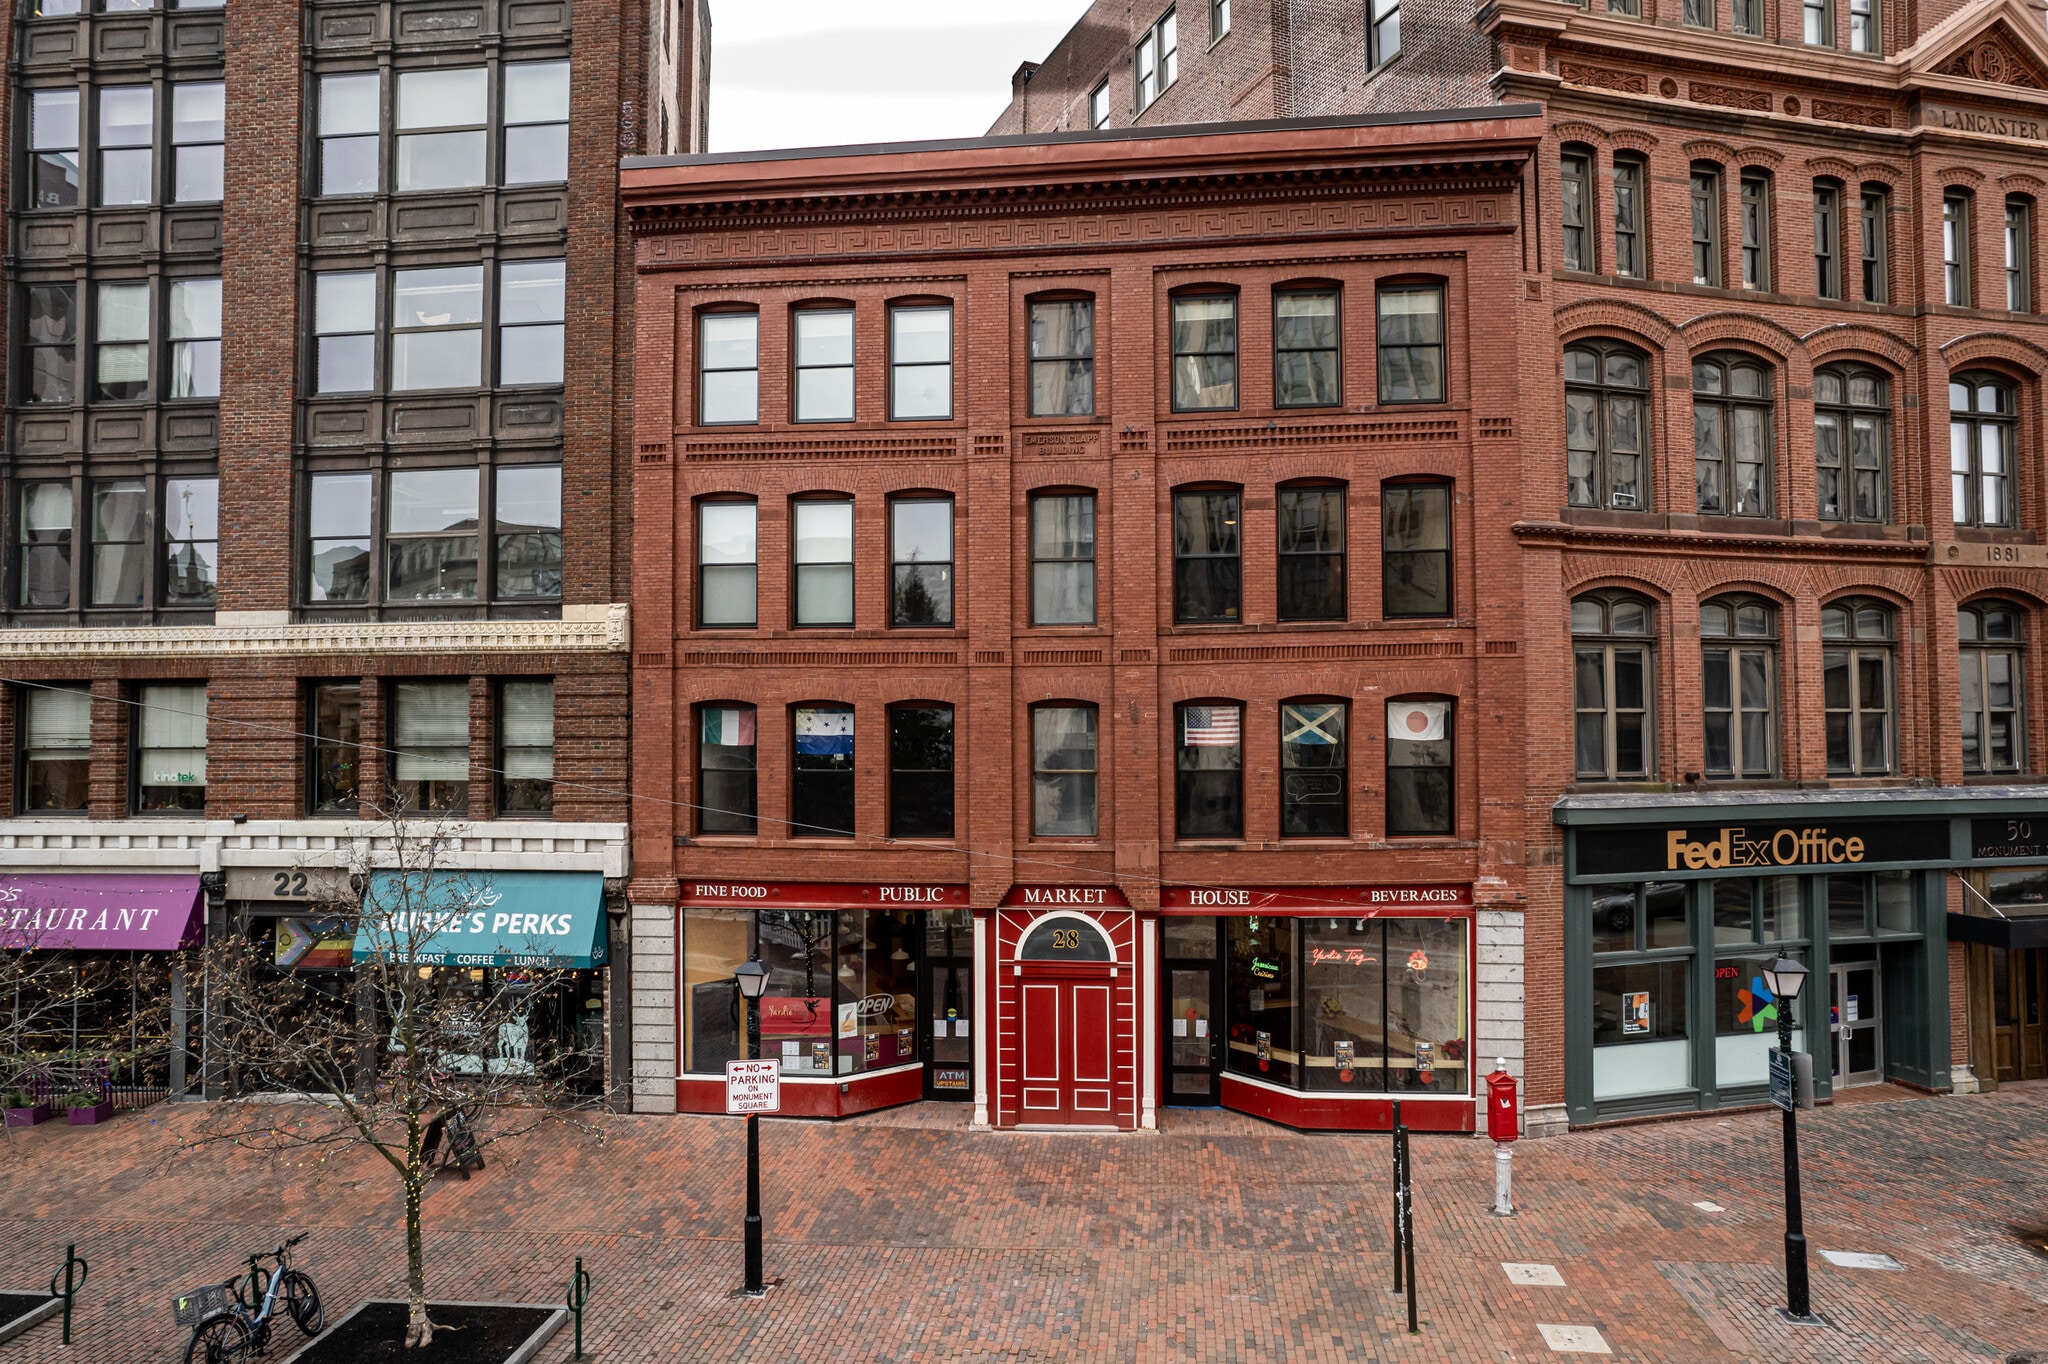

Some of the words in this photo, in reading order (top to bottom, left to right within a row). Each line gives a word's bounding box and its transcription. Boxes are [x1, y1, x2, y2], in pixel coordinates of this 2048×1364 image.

[1941, 110, 2041, 140] LANCASTER
[1024, 435, 1066, 445] EMERSON
[1068, 434, 1099, 444] CLAPP
[1039, 446, 1085, 455] BUILDING
[1987, 546, 2019, 562] 1881
[153, 771, 195, 782] kinotek
[2007, 820, 2031, 841] 50
[1667, 828, 1771, 870] FedEx
[1772, 828, 1865, 866] Office
[1977, 845, 2040, 857] MONUMENT
[274, 872, 308, 896] 22
[695, 885, 728, 896] FINE
[731, 886, 767, 898] FOOD
[879, 887, 944, 902] PUBLIC
[1024, 888, 1107, 903] MARKET
[1189, 890, 1250, 905] HOUSE
[1371, 890, 1458, 902] BEVERAGES
[380, 911, 486, 934] BURKE'S
[492, 913, 572, 936] PERKS
[1053, 929, 1079, 949] 28
[389, 951, 446, 964] BREKFAST
[456, 954, 495, 965] COFFEE
[514, 955, 550, 967] LUNCH
[1312, 948, 1342, 966] Yardie
[1343, 948, 1376, 966] Ting
[768, 1004, 793, 1017] Yardie
[857, 997, 891, 1014] OPEN
[746, 1063, 760, 1073] NO
[731, 1074, 775, 1085] PARKING
[939, 1071, 965, 1080] ATM
[733, 1093, 773, 1101] MONUMENT
[738, 1102, 768, 1110] SQUARE
